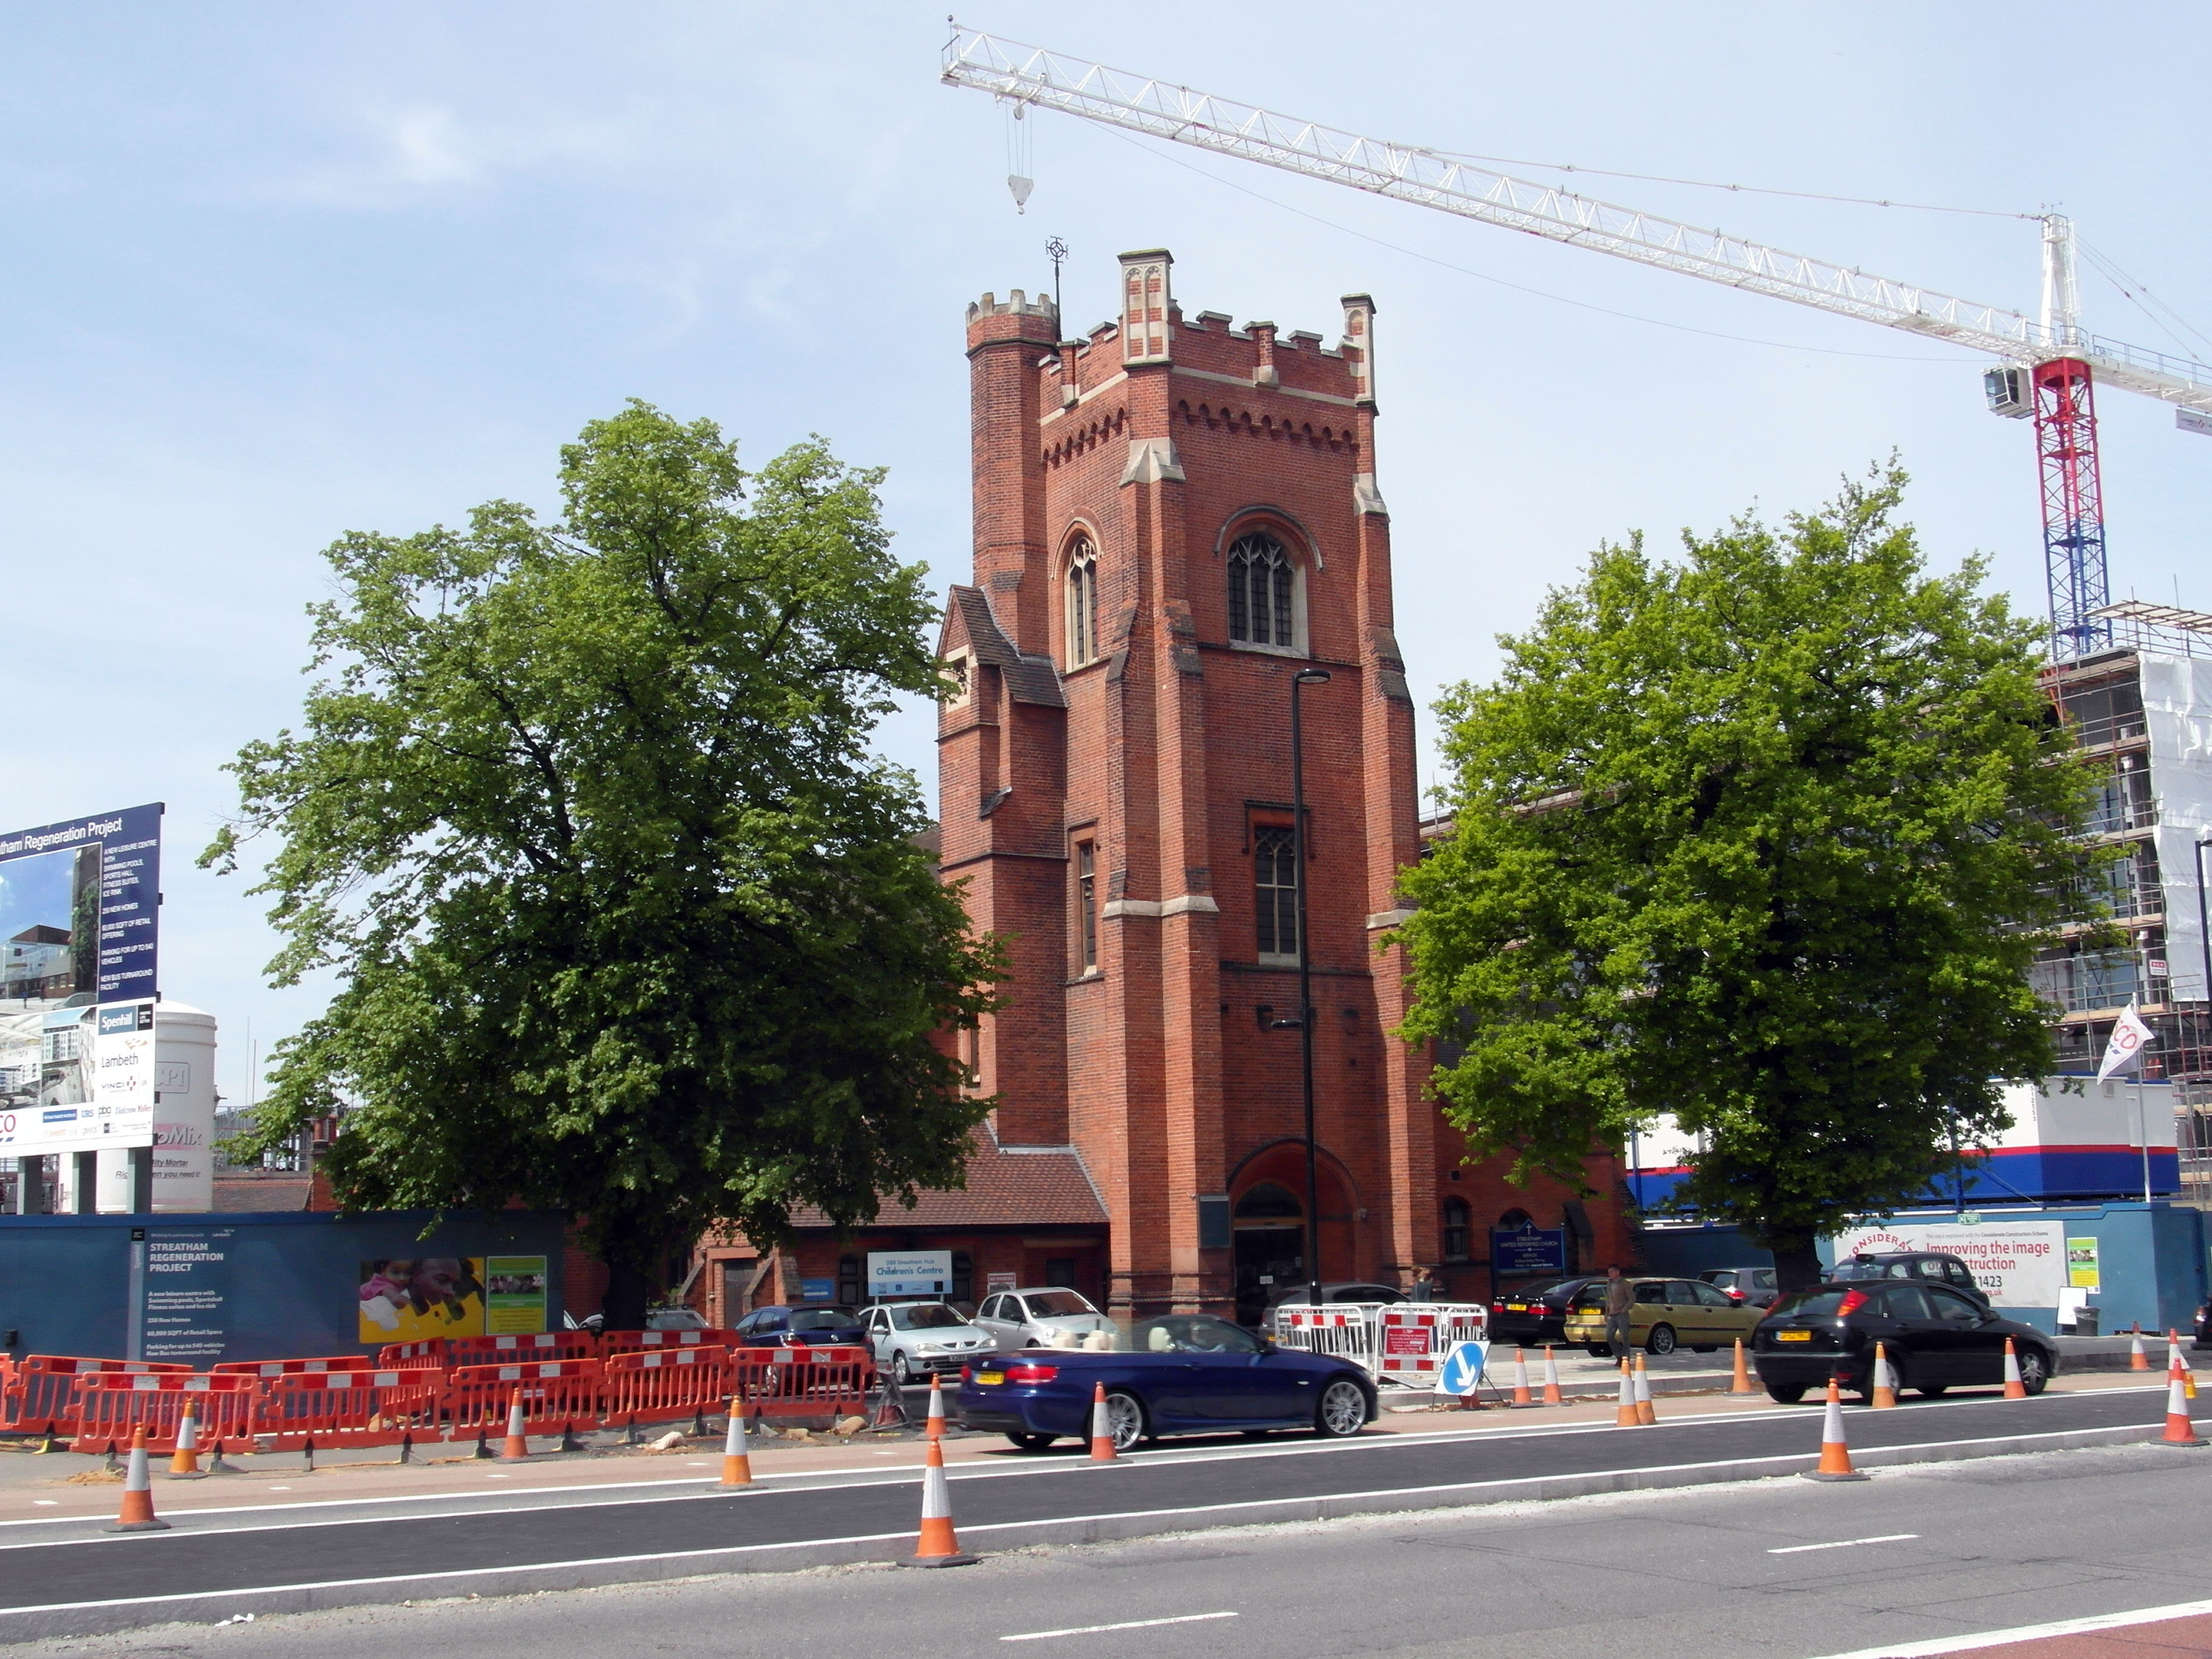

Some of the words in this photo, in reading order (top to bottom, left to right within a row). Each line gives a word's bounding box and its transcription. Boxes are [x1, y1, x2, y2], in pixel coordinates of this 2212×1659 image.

[0, 840, 22, 855] tham
[25, 826, 85, 850] Regeneration
[88, 817, 122, 837] Project
[138, 839, 157, 848] CENTRE
[101, 948, 121, 956] PARKING
[101, 956, 122, 965] VEHICLES
[102, 1012, 132, 1031] Spenhill
[101, 1052, 138, 1068] Lambeth
[157, 1127, 203, 1145] oMix
[1848, 1233, 1912, 1255] ONSIDERA
[1926, 1242, 1986, 1258] Improving
[1990, 1241, 2009, 1253] the
[2013, 1241, 2050, 1257] image
[149, 1253, 224, 1261] REGENERATION
[1948, 1257, 2016, 1270] onstruction
[876, 1267, 914, 1275] Children's
[1979, 1276, 2002, 1287] 1423
[1982, 1289, 2002, 1298] org.uk
